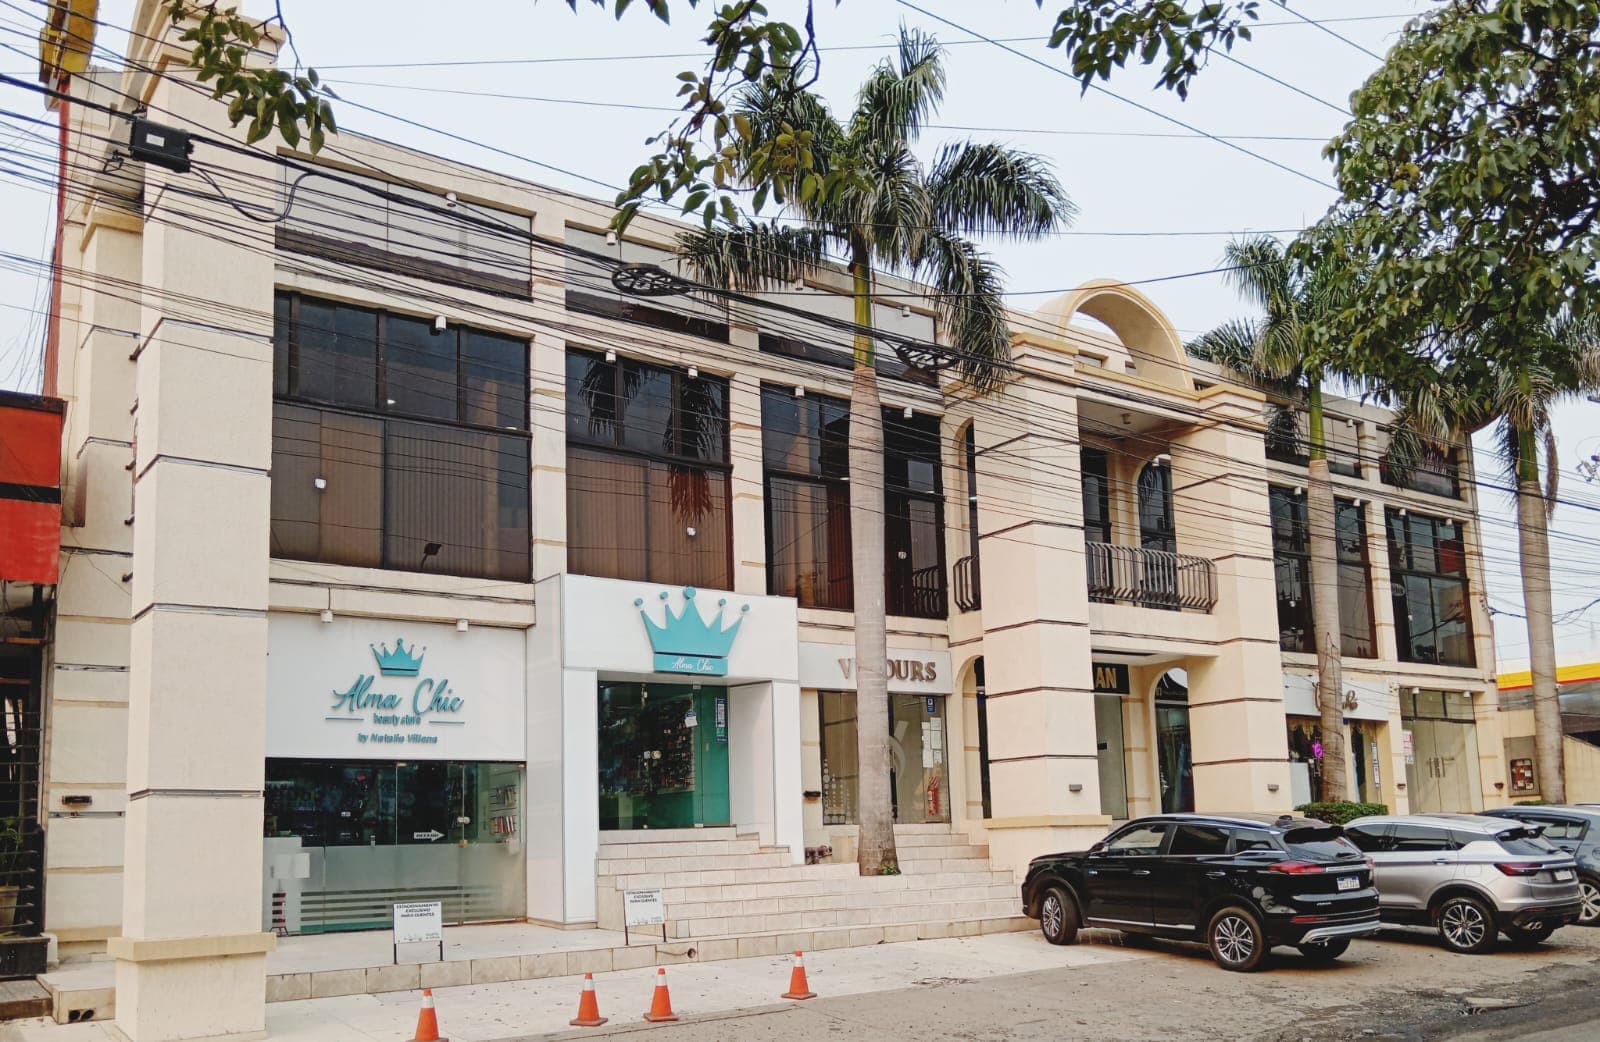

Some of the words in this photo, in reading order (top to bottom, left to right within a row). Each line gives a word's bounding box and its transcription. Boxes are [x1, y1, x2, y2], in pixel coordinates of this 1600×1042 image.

[673, 657, 693, 671] Alma
[697, 658, 715, 672] Chic
[837, 658, 937, 681] VOURS
[331, 674, 402, 712] Alma
[412, 678, 465, 716] Chic
[373, 713, 400, 727] beauty
[357, 732, 369, 745] by
